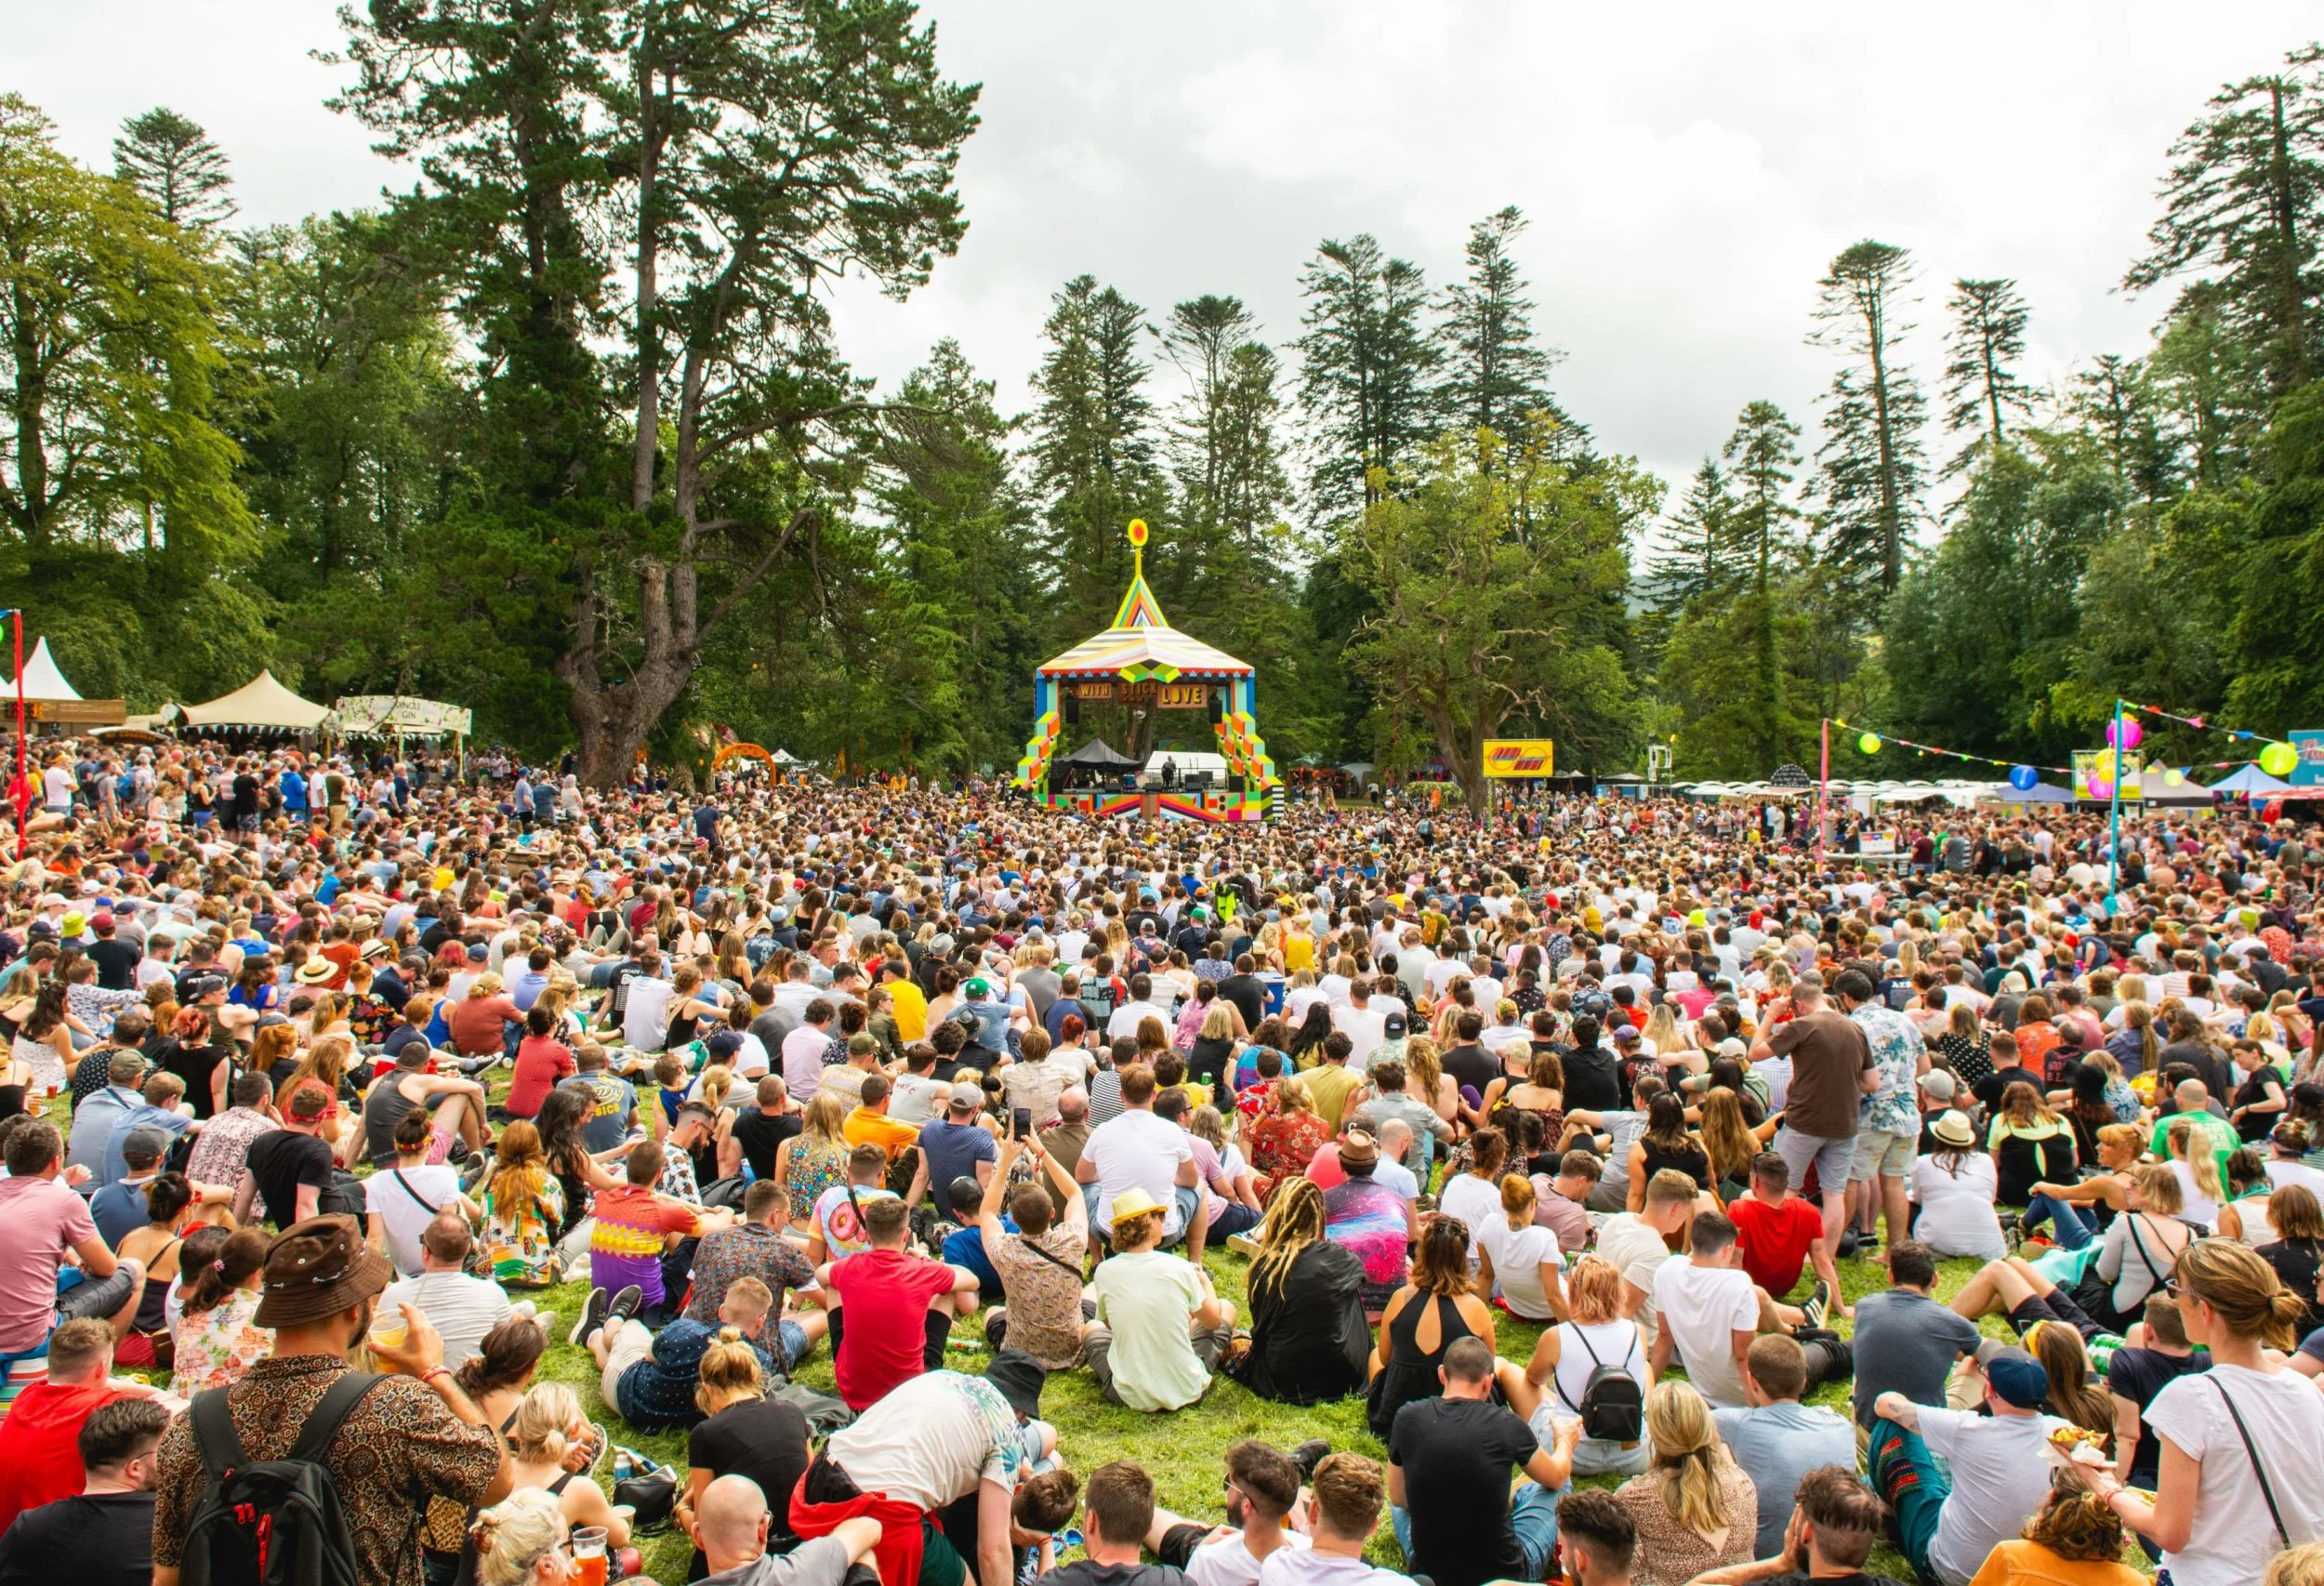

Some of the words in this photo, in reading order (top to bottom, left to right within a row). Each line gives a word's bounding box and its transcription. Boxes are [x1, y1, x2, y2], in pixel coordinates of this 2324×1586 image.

[1080, 684, 1109, 696] WITH
[1161, 687, 1202, 704] LOVE
[402, 710, 416, 719] GIN
[595, 1103, 621, 1117] SICS
